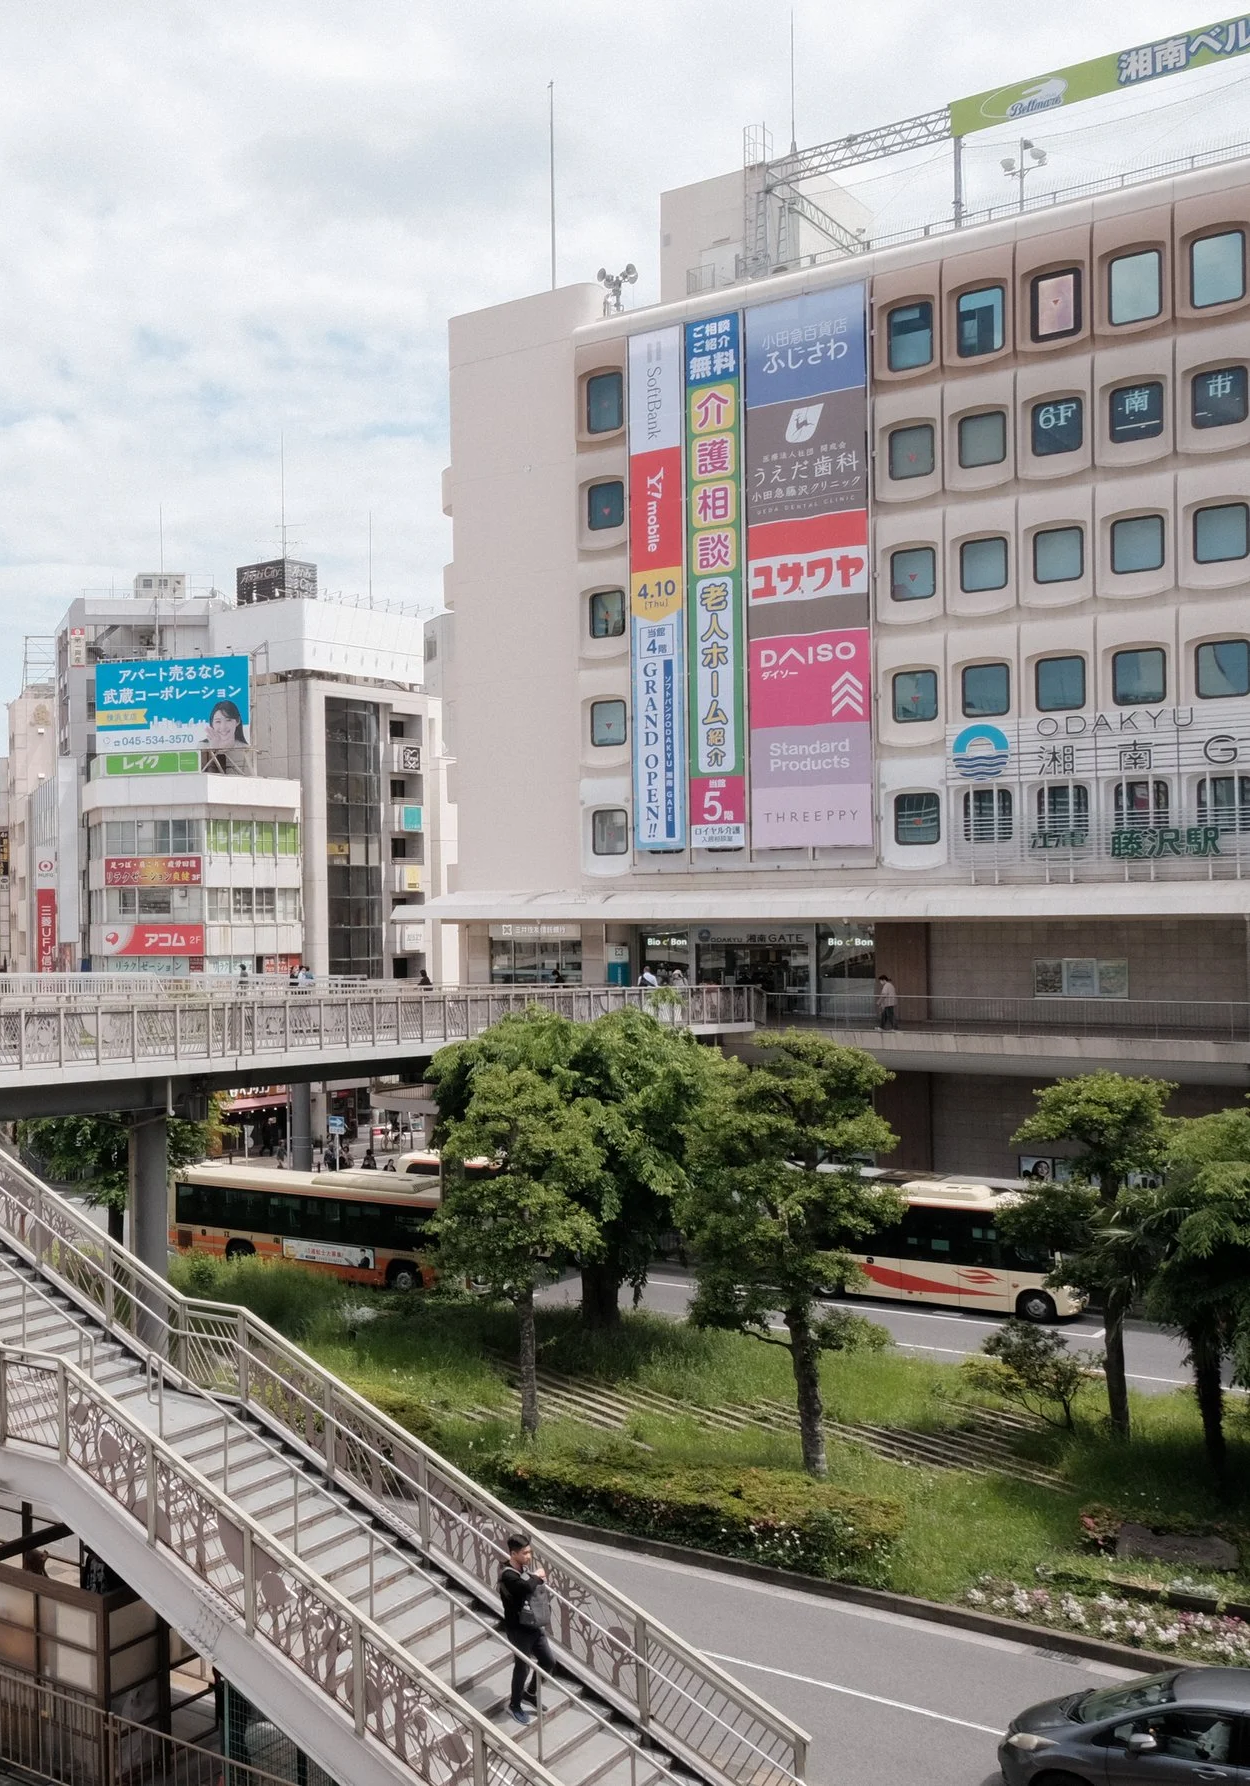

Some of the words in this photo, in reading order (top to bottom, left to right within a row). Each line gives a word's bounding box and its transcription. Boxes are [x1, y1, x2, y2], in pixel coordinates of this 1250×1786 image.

[693, 319, 730, 338] ご相談
[762, 318, 847, 350] 小田急百貨店
[693, 335, 730, 353] ご紹介
[690, 349, 735, 380] 無料
[762, 338, 848, 374] ふじさわ
[647, 366, 662, 440] SoftBank
[1038, 402, 1076, 429] 6F
[754, 451, 860, 488] うえだ歯科
[696, 392, 730, 569] 介護相談
[751, 476, 861, 503] 小田急藤沢クリニック
[757, 507, 779, 516] UEDA
[784, 502, 818, 511] DENTAL
[823, 494, 855, 505] CLINIC
[637, 579, 676, 600] 4.10
[648, 627, 666, 639] 当館
[647, 639, 668, 654] 4階
[760, 641, 856, 668] DAISO
[118, 664, 225, 684] アパート売るなら
[700, 582, 729, 767] 老人ホーム紹介
[760, 669, 799, 681] ダイソー
[102, 686, 242, 706] 武蔵コーポレーション
[643, 661, 658, 747] GRAND
[1036, 707, 1194, 737] ODAKYU
[121, 734, 194, 746] 045-534-3570
[769, 738, 850, 756] Standard
[122, 755, 160, 770] レイク
[769, 755, 850, 772] Products
[1038, 739, 1155, 776] 湘南
[708, 779, 727, 789] 当館
[644, 753, 660, 838] OPEN!!
[703, 791, 734, 822] 5階
[764, 809, 859, 823] THREEPPY
[694, 826, 741, 836] ロイヤル介護
[1110, 826, 1221, 858] 藤沢駅
[144, 932, 186, 948] アコム
[190, 936, 202, 945] 2F
[647, 938, 661, 946] Bio
[670, 938, 688, 946] Bon
[746, 934, 766, 943] 湘南
[767, 934, 805, 943] GATE
[827, 938, 843, 946] Bio
[854, 938, 874, 946] Bon
[115, 961, 183, 973] リラクゼーション
